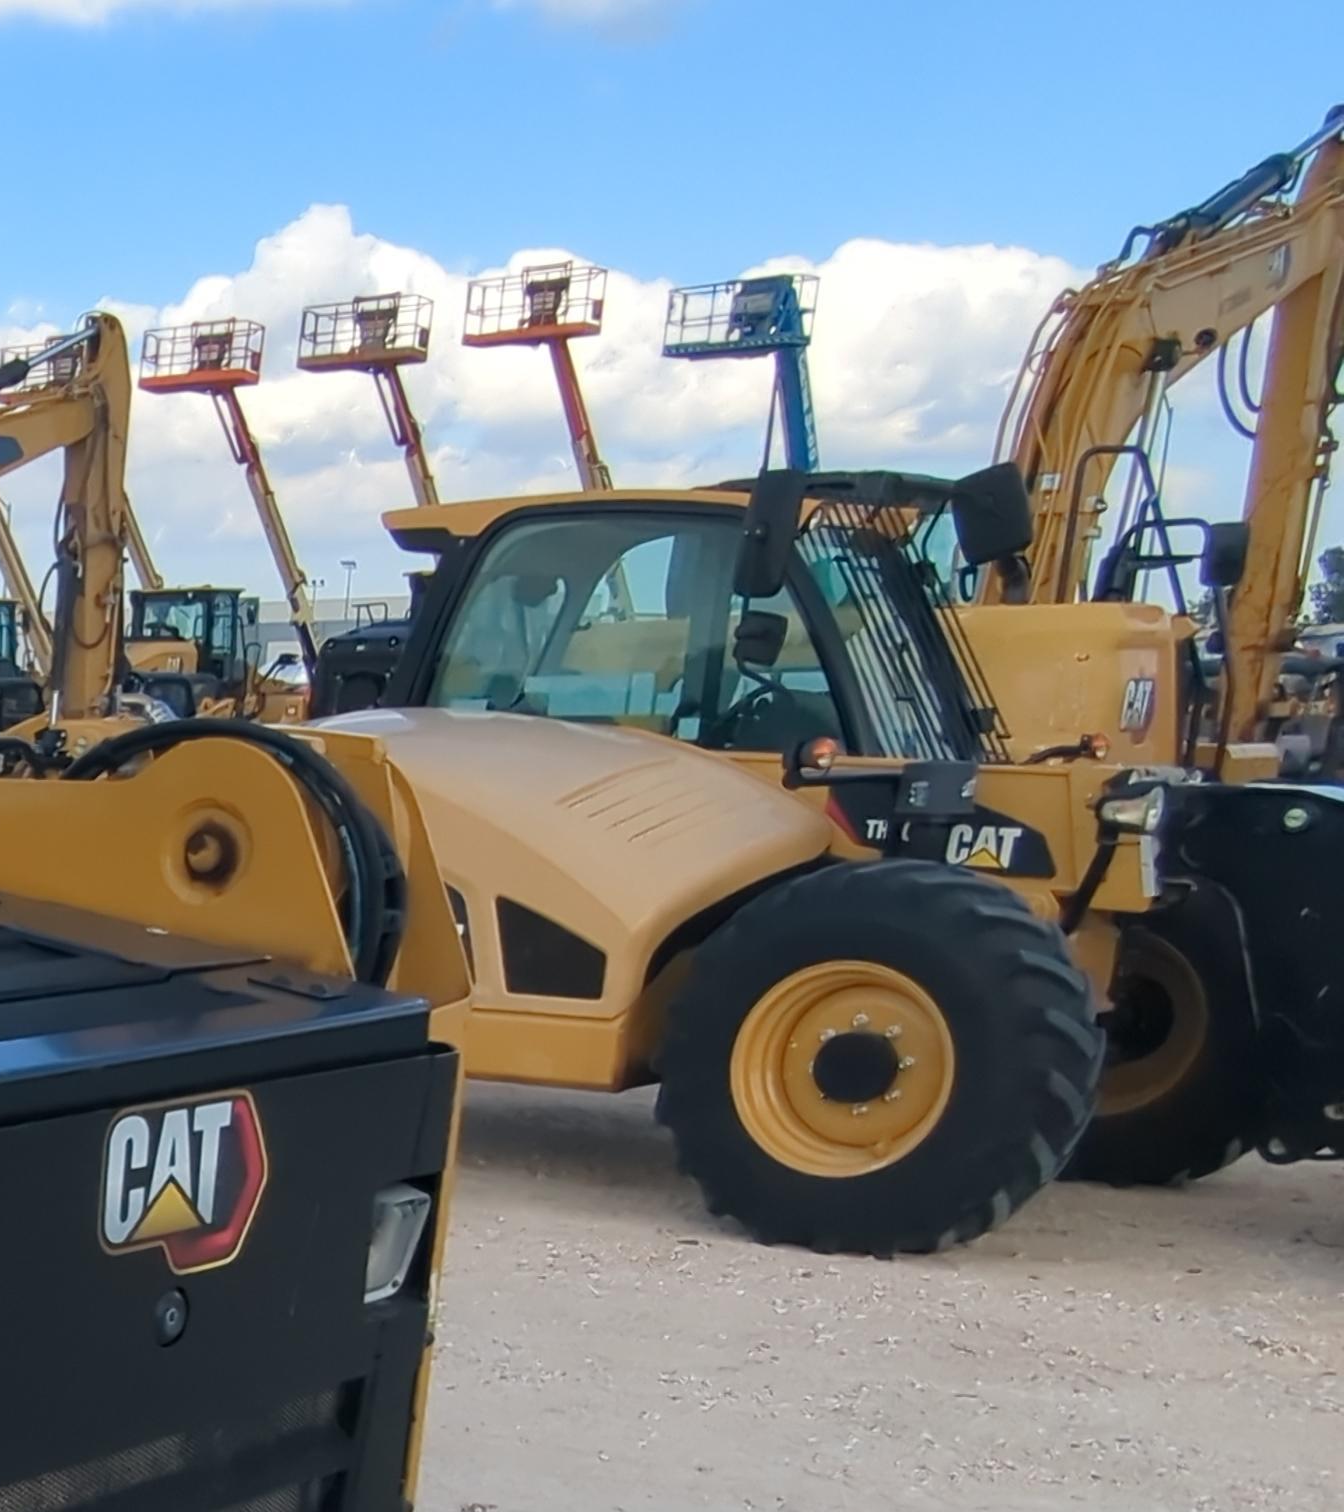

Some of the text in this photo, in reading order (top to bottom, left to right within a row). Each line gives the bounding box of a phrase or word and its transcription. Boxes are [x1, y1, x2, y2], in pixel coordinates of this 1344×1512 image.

[1120, 680, 1153, 730] CAT
[945, 824, 1024, 873] CAT
[103, 1101, 233, 1244] CAT
